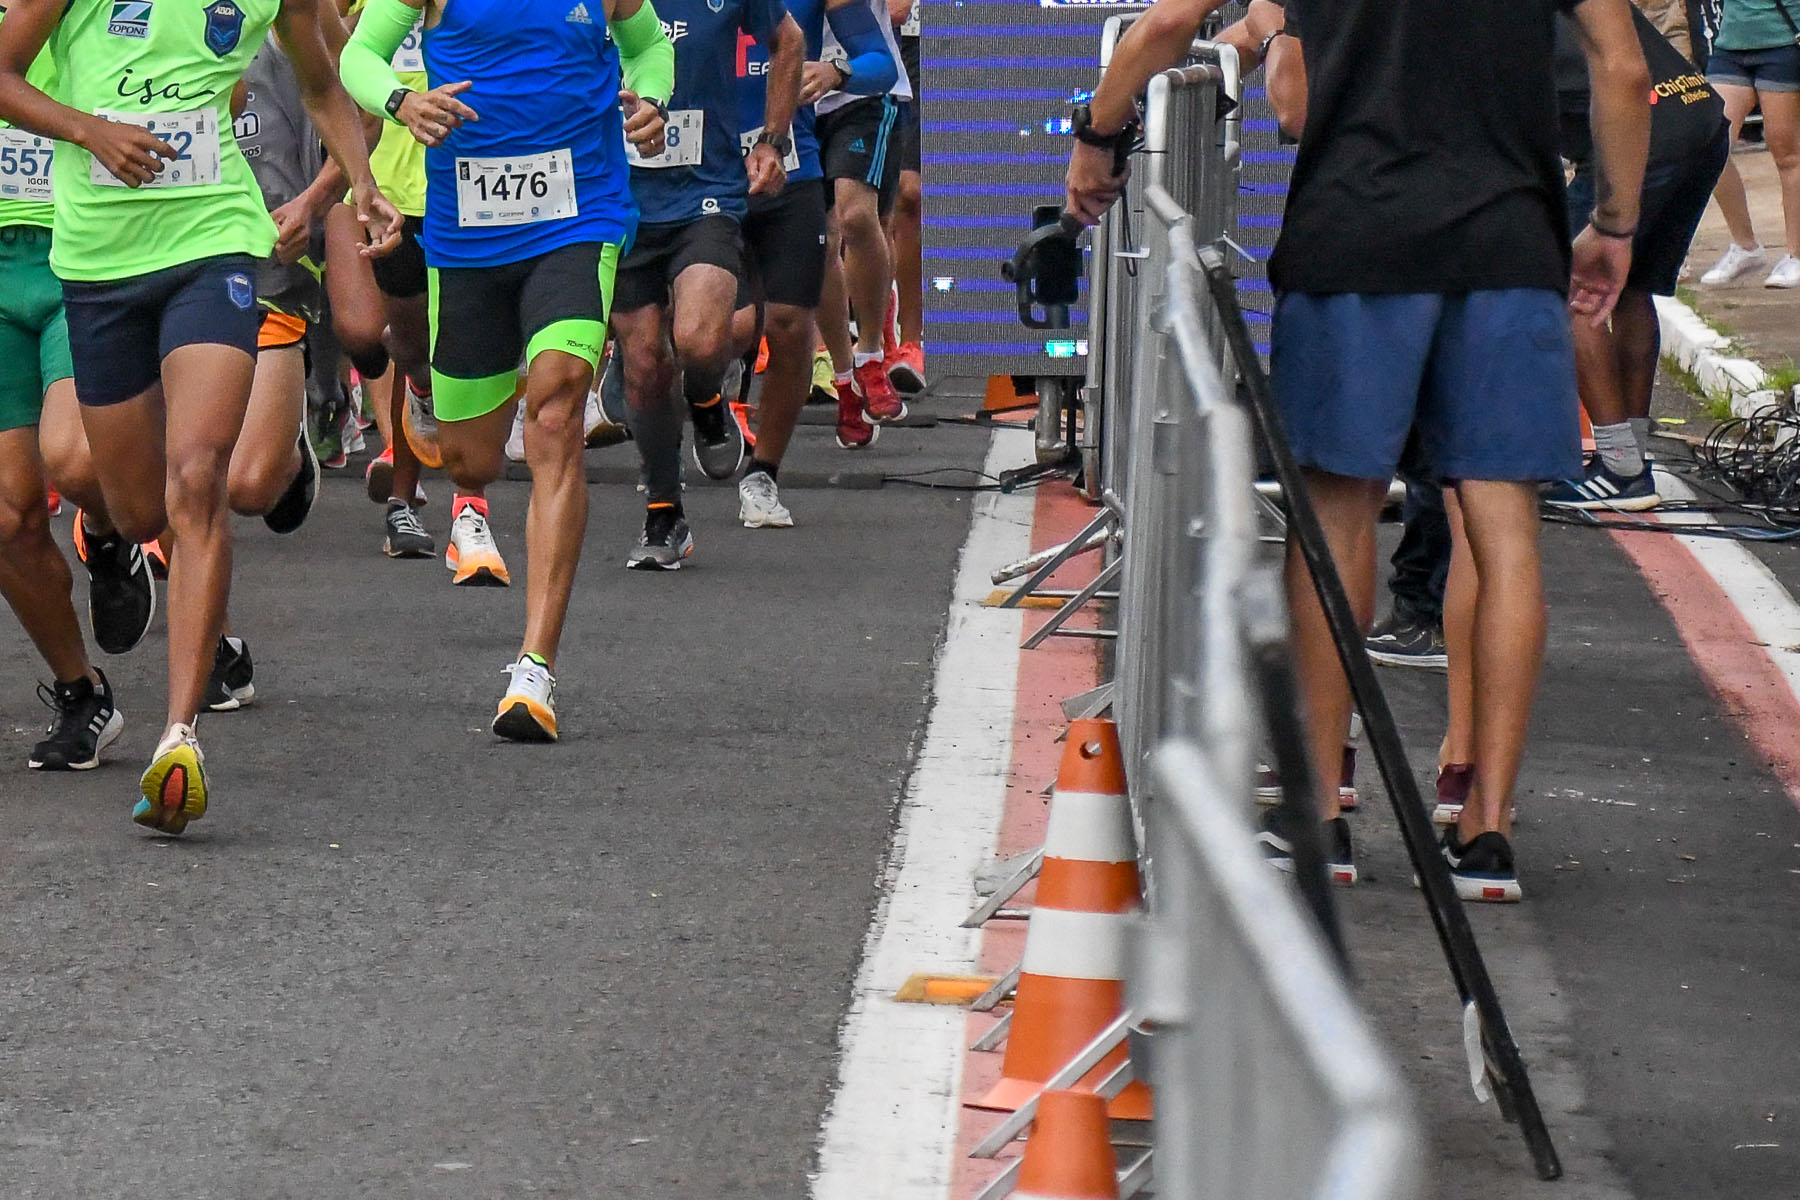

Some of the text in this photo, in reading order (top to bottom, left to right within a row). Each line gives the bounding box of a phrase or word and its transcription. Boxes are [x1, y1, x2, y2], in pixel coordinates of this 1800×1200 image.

[108, 24, 148, 36] ZOPONE
[117, 68, 216, 105] isa
[27, 177, 49, 186] IGOR
[473, 170, 549, 201] 1476
